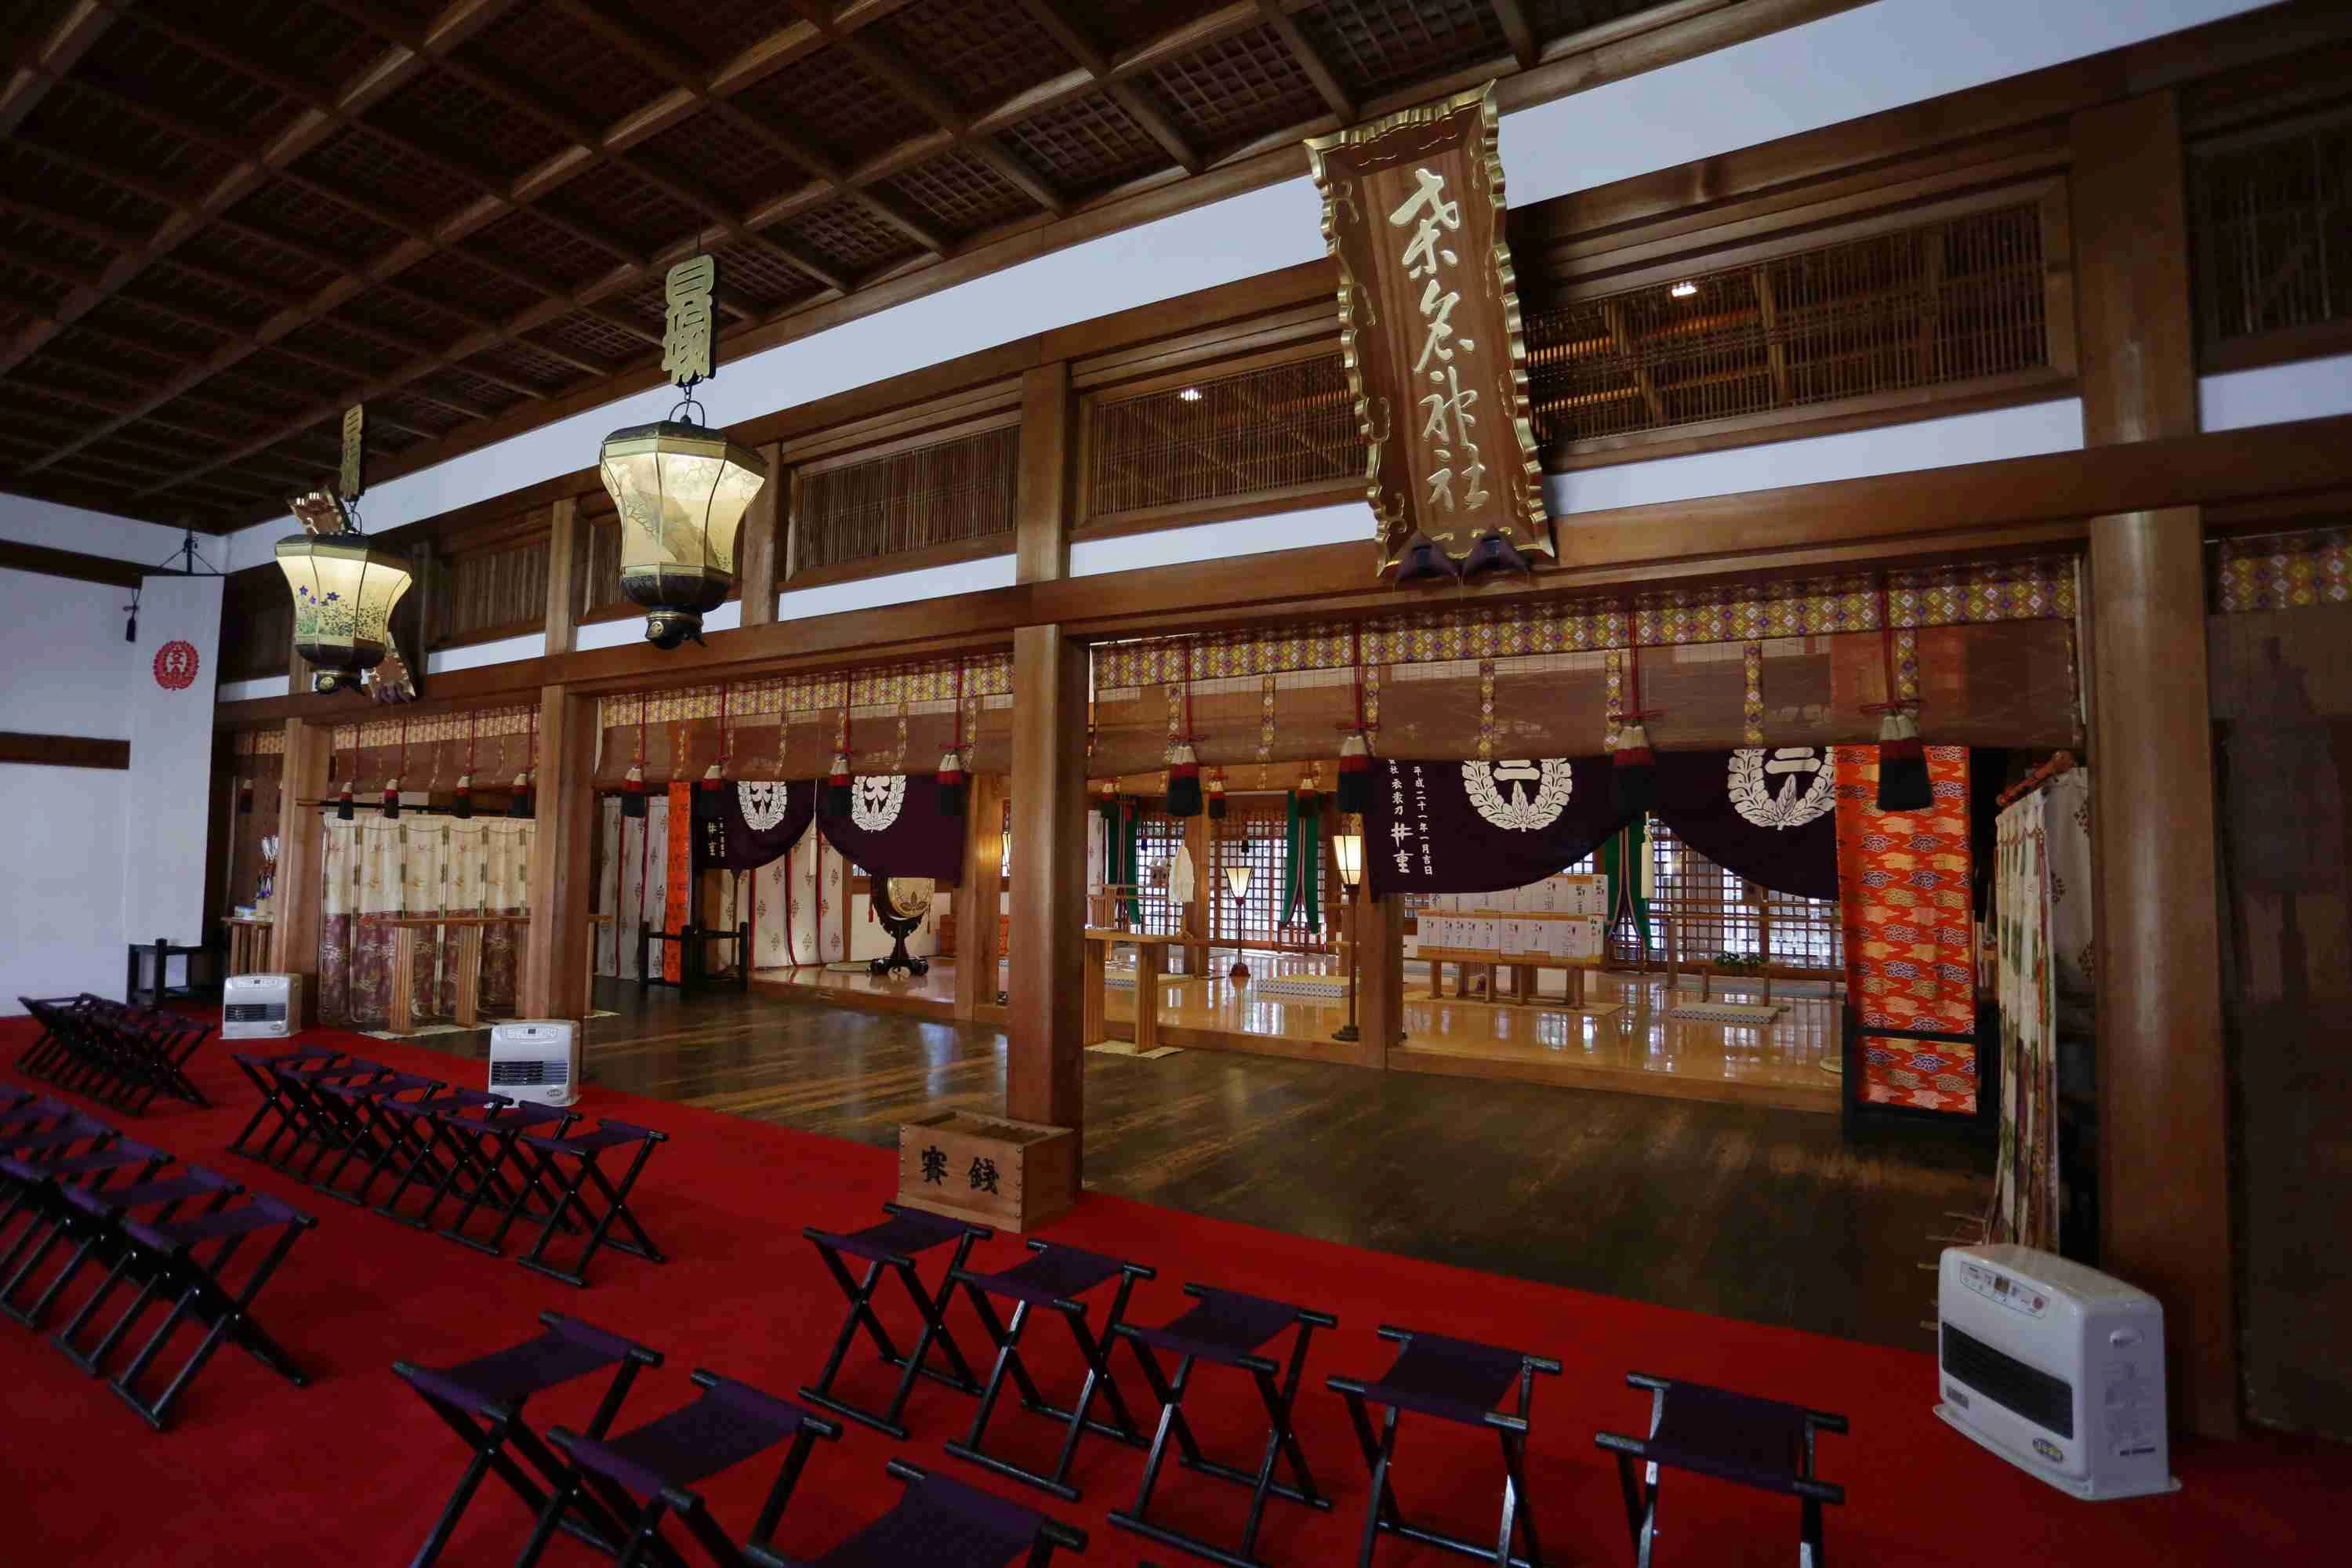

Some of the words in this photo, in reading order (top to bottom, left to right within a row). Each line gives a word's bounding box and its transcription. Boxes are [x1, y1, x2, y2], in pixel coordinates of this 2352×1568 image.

[1413, 765, 1433, 876] 平成二十一年一月吉日
